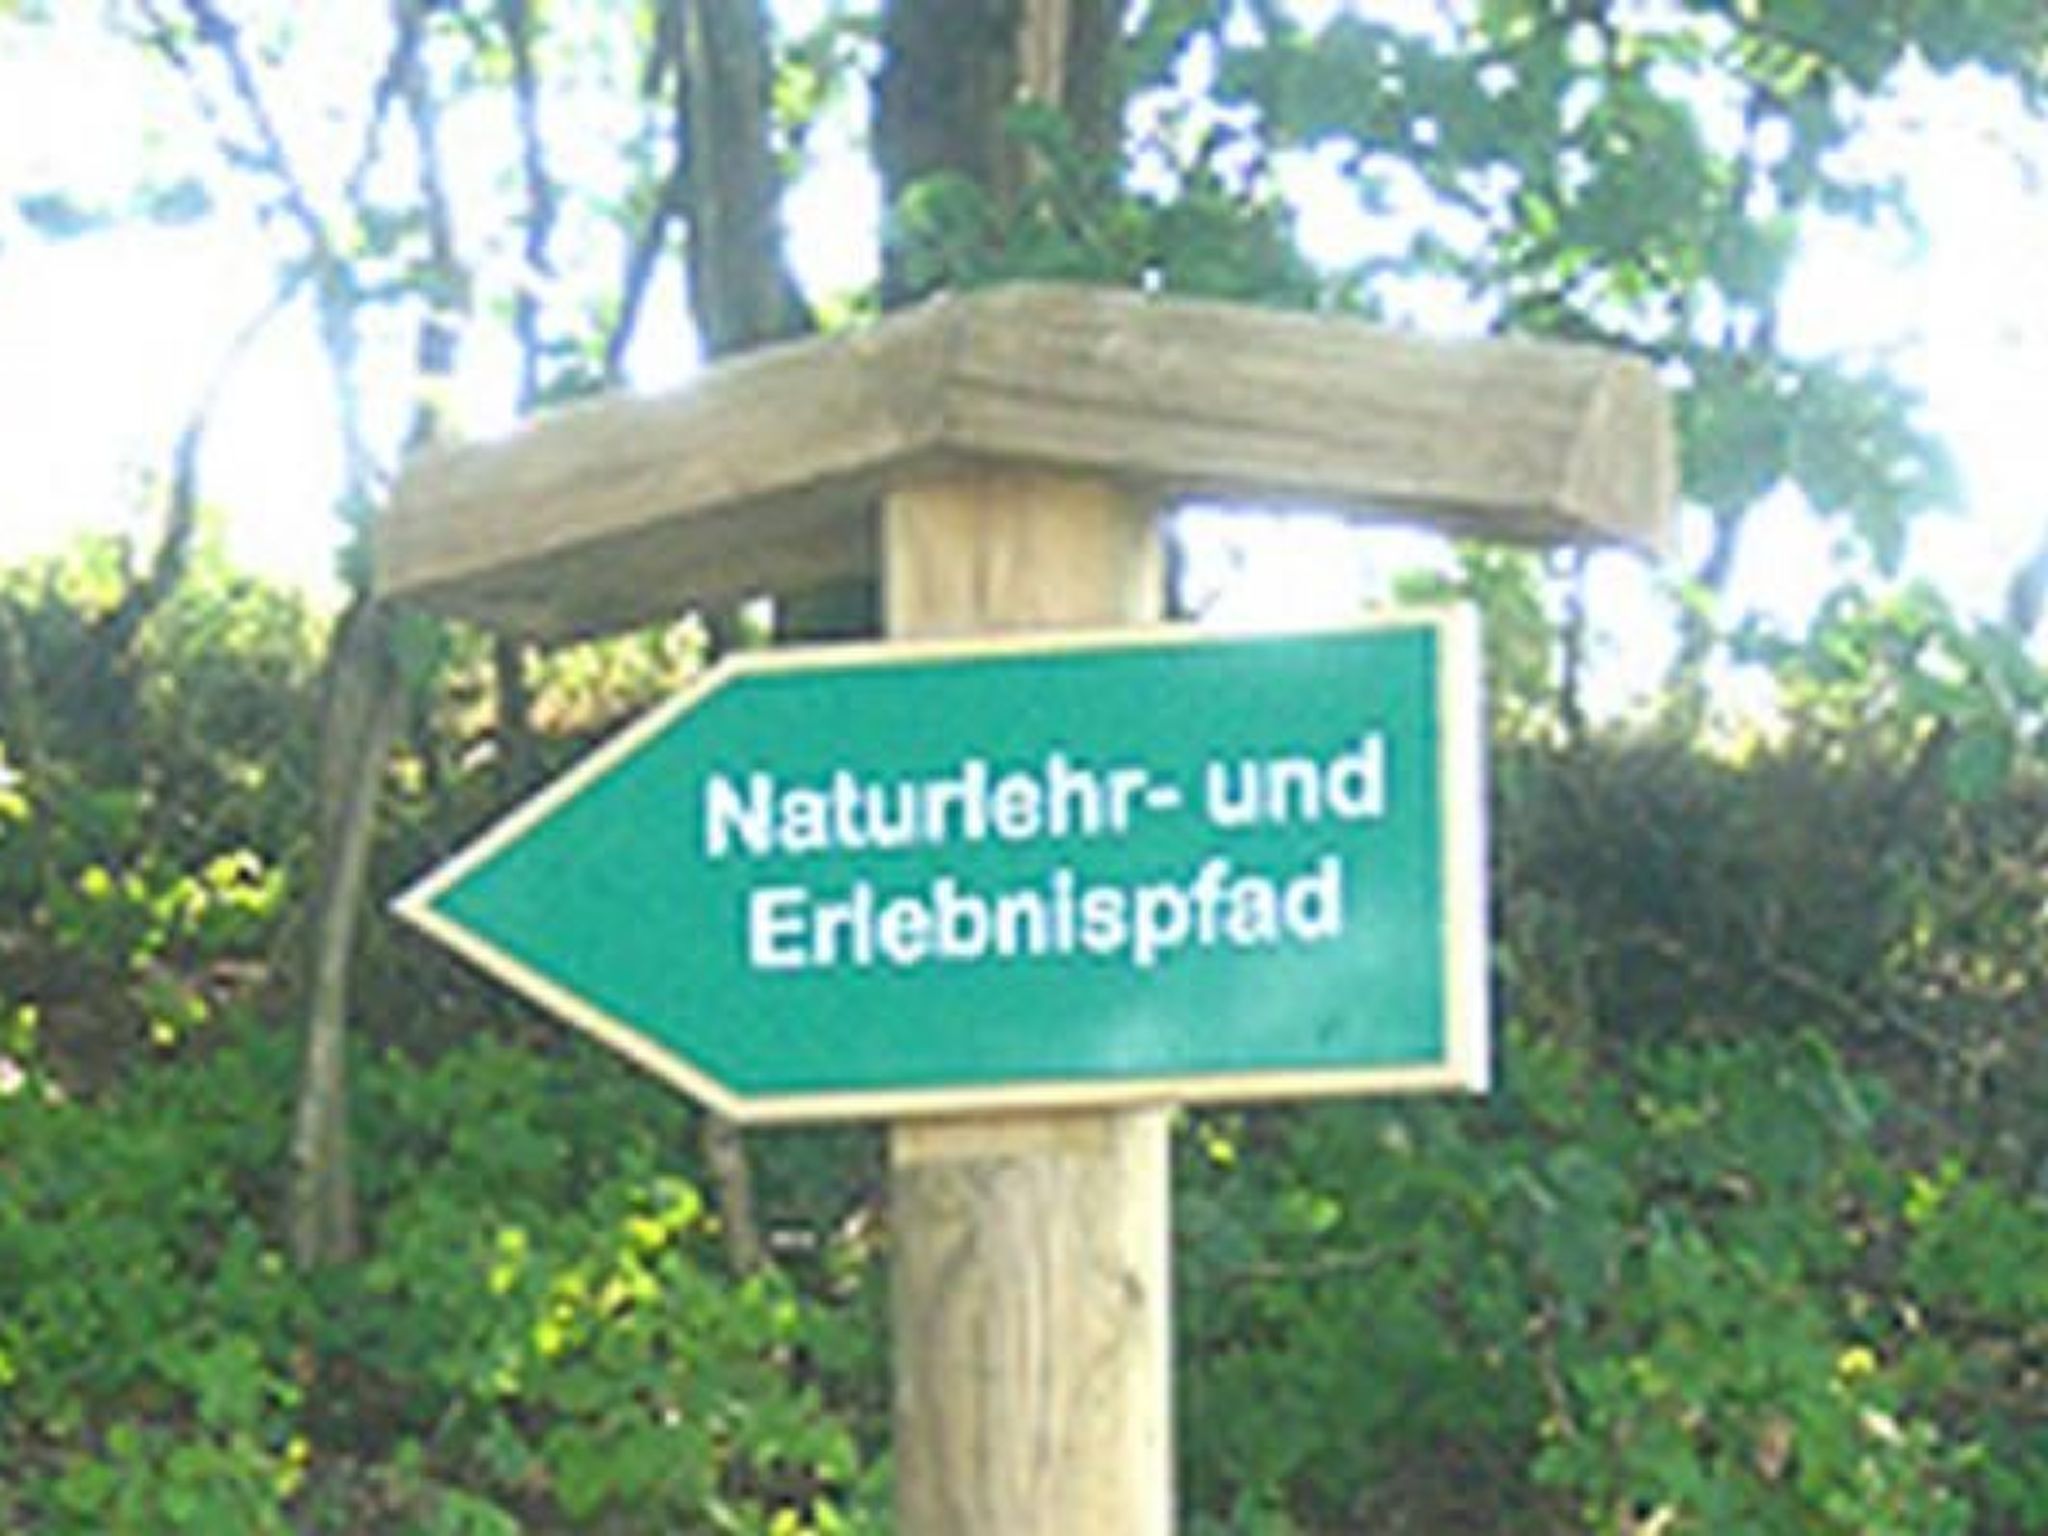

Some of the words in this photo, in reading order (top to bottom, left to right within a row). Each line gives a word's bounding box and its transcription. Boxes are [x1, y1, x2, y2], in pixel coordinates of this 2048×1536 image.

[705, 753, 1182, 857] Naturlehr-
[1206, 732, 1386, 827] und
[748, 856, 1344, 969] Erlebnispfad
